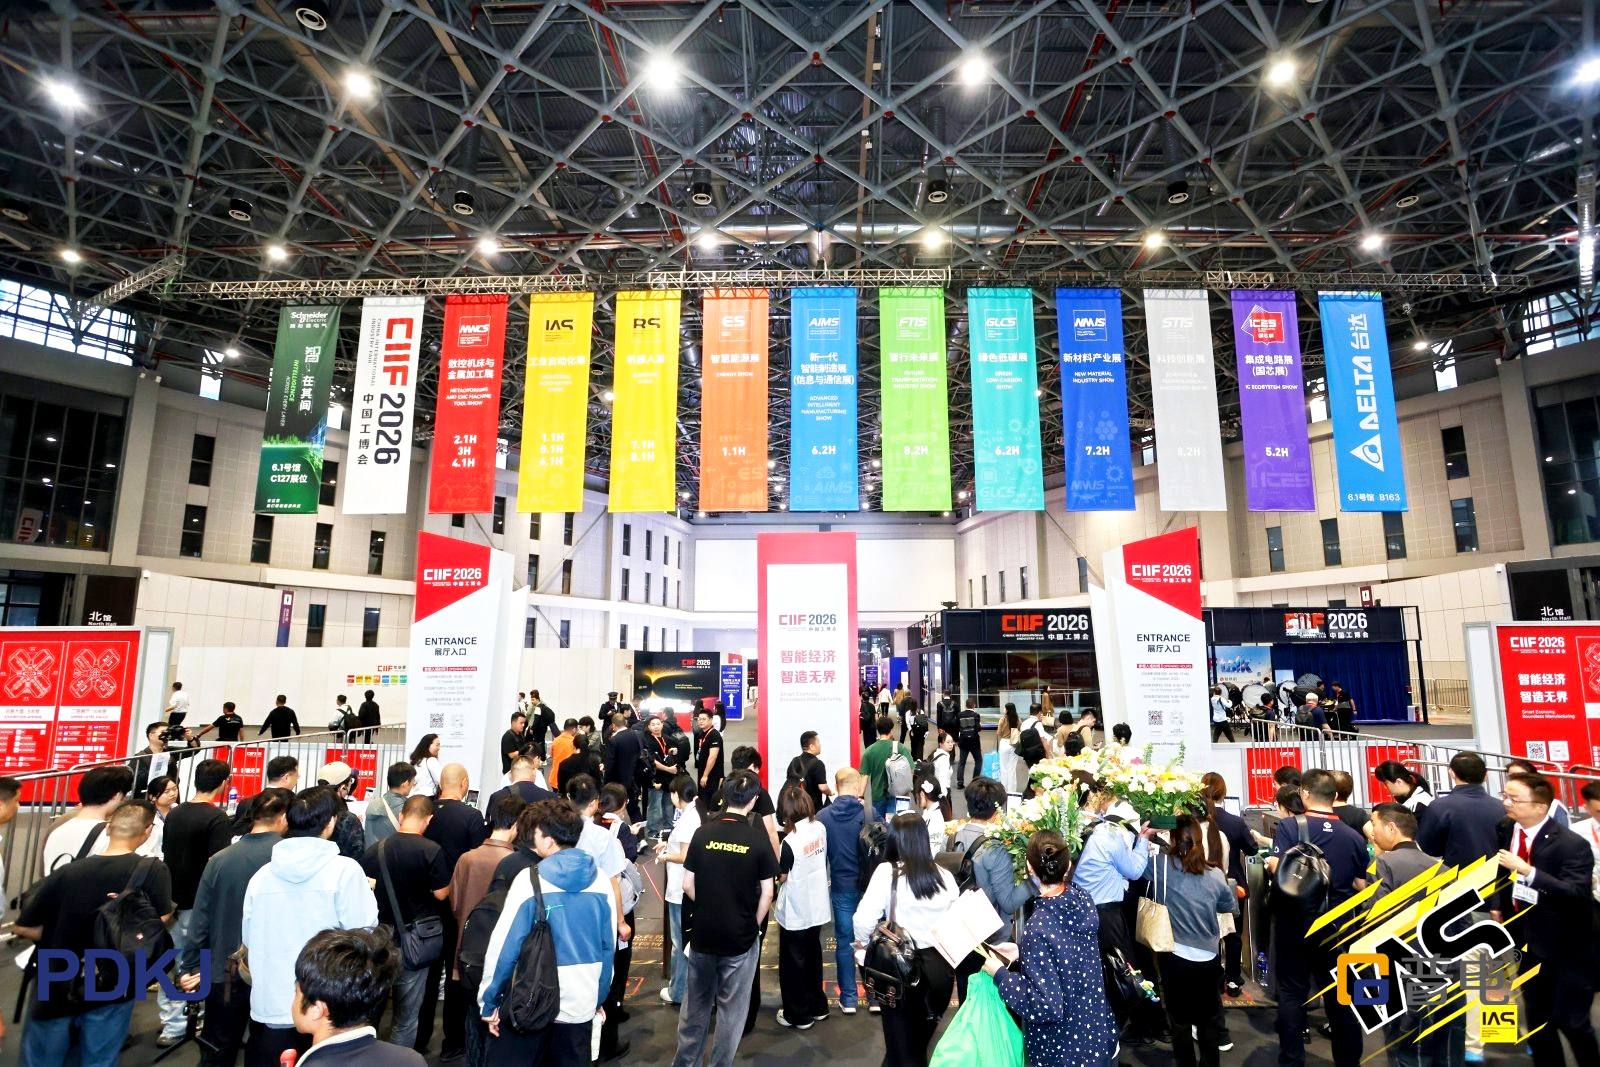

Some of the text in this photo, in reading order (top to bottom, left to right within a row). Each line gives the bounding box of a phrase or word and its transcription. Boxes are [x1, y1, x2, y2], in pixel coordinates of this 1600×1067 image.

[290, 312, 328, 321] Schneider
[899, 317, 928, 326] FTIS
[546, 320, 574, 330] IAS
[634, 318, 660, 328] RS
[722, 316, 746, 328] ES
[808, 318, 839, 326] AIMS
[986, 318, 1016, 326] GLCS
[1162, 317, 1193, 328] STIS
[1250, 319, 1276, 328] ICES
[1348, 314, 1370, 350] 台达
[710, 354, 760, 364] 智慧能源展
[810, 352, 838, 361] 新一代
[889, 352, 938, 362] 智行未来展
[978, 352, 1028, 362] 绿色低碳展
[1063, 353, 1122, 363] 新材料产业展
[1157, 354, 1206, 364] 科技创新展
[1245, 354, 1294, 364] 集成电路展
[448, 358, 494, 368] 数控机床与
[800, 364, 846, 374] 智能制造展
[1252, 366, 1288, 376] (国芯展)
[300, 346, 321, 411] 智 在其间
[448, 369, 494, 380] 金属加工展
[289, 360, 300, 402] INTELLIGENCE
[374, 318, 414, 464] CIIF 2026
[358, 394, 374, 465] 中国工博会
[454, 435, 477, 444] 2.1H
[541, 433, 564, 442] 1.1H
[540, 444, 564, 454] 5.1H
[632, 440, 655, 450] 7.1H
[458, 446, 471, 456] 3H
[722, 446, 746, 456] 1.1H
[812, 446, 836, 455] 6.2H
[904, 446, 928, 455] 8.2H
[995, 446, 1020, 456] 6.2H
[1086, 446, 1110, 456] 7.2H
[1177, 446, 1200, 456] 8.2H
[1266, 447, 1288, 456] 5.2H
[540, 456, 564, 466] 6.1H
[630, 452, 655, 462] 8.1H
[272, 464, 301, 472] 6.1号馆
[452, 458, 475, 468] 4.1H
[270, 474, 308, 483] C127展位
[1348, 493, 1400, 502] 6.1号馆 B163
[424, 568, 482, 580] CIIF 2026
[1132, 565, 1192, 576] CIIF 2026
[89, 611, 112, 621] 北馆
[1540, 606, 1564, 616] 北馆
[778, 614, 836, 625] CIIF 2026
[1002, 614, 1088, 631] CIIF 2026
[1328, 613, 1368, 630] 2026
[425, 637, 478, 645] ENTRANCE
[1136, 634, 1190, 642] ENTRANCE
[1510, 637, 1564, 648] CIIF 2026
[434, 648, 466, 656] 展厅入口
[780, 650, 836, 663] 智能经济
[780, 670, 836, 684] 智造无界
[1518, 674, 1566, 686] 智能经济
[1520, 690, 1568, 703] 智造无界
[706, 841, 750, 854] Jonstar
